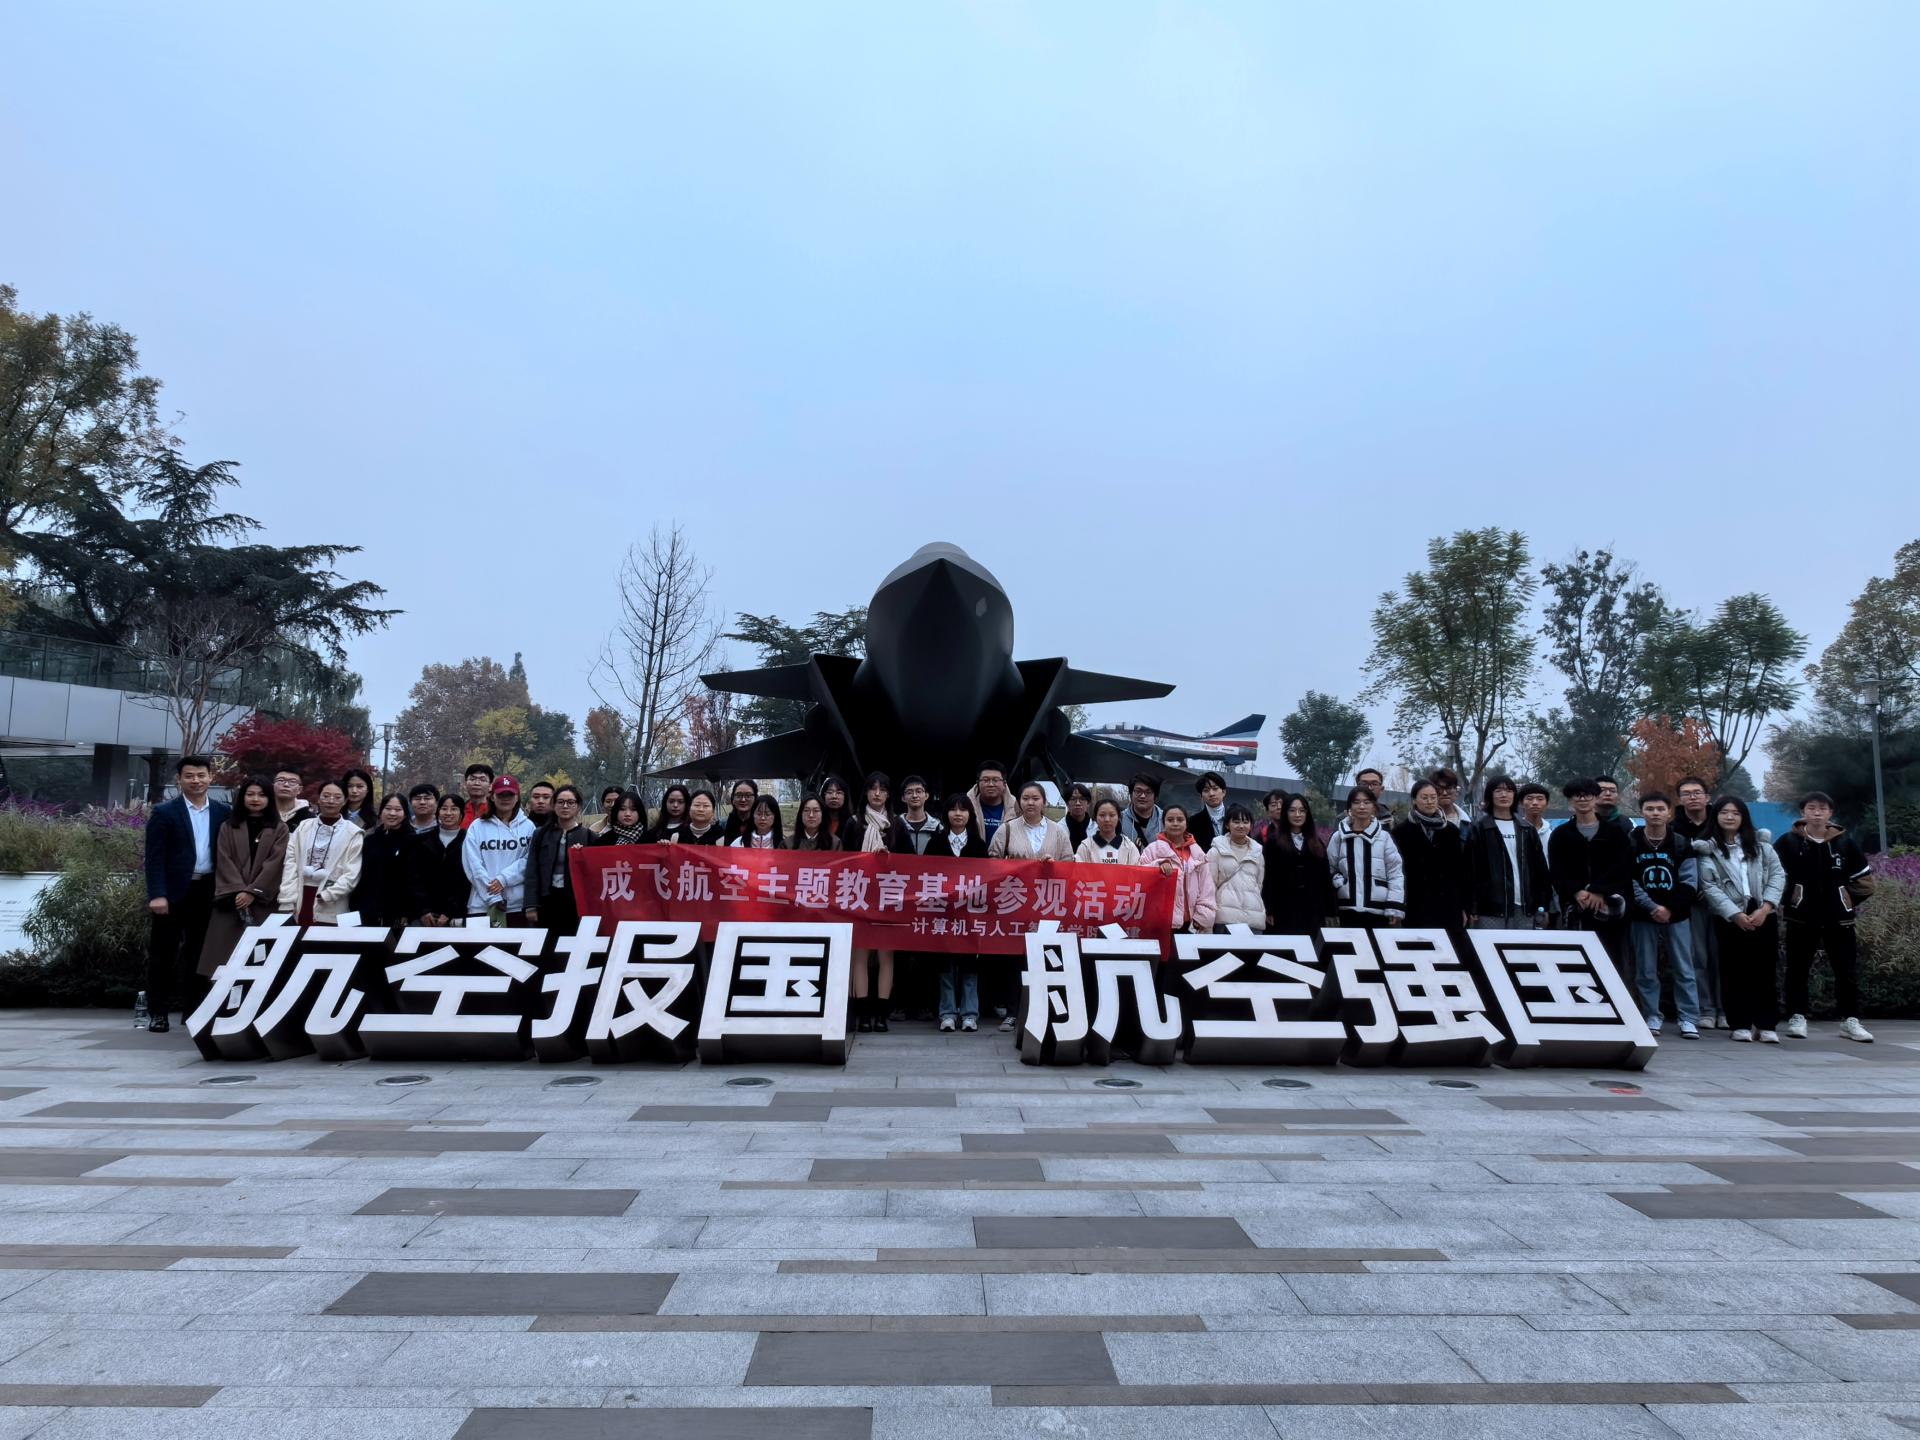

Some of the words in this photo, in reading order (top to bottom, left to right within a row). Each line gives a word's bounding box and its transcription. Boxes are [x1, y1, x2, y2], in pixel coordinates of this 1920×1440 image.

[600, 860, 1147, 922] 成飞航空主题教育基地参观活动
[187, 912, 853, 1040] 航空报国
[1022, 919, 1658, 1047] 航空强国
